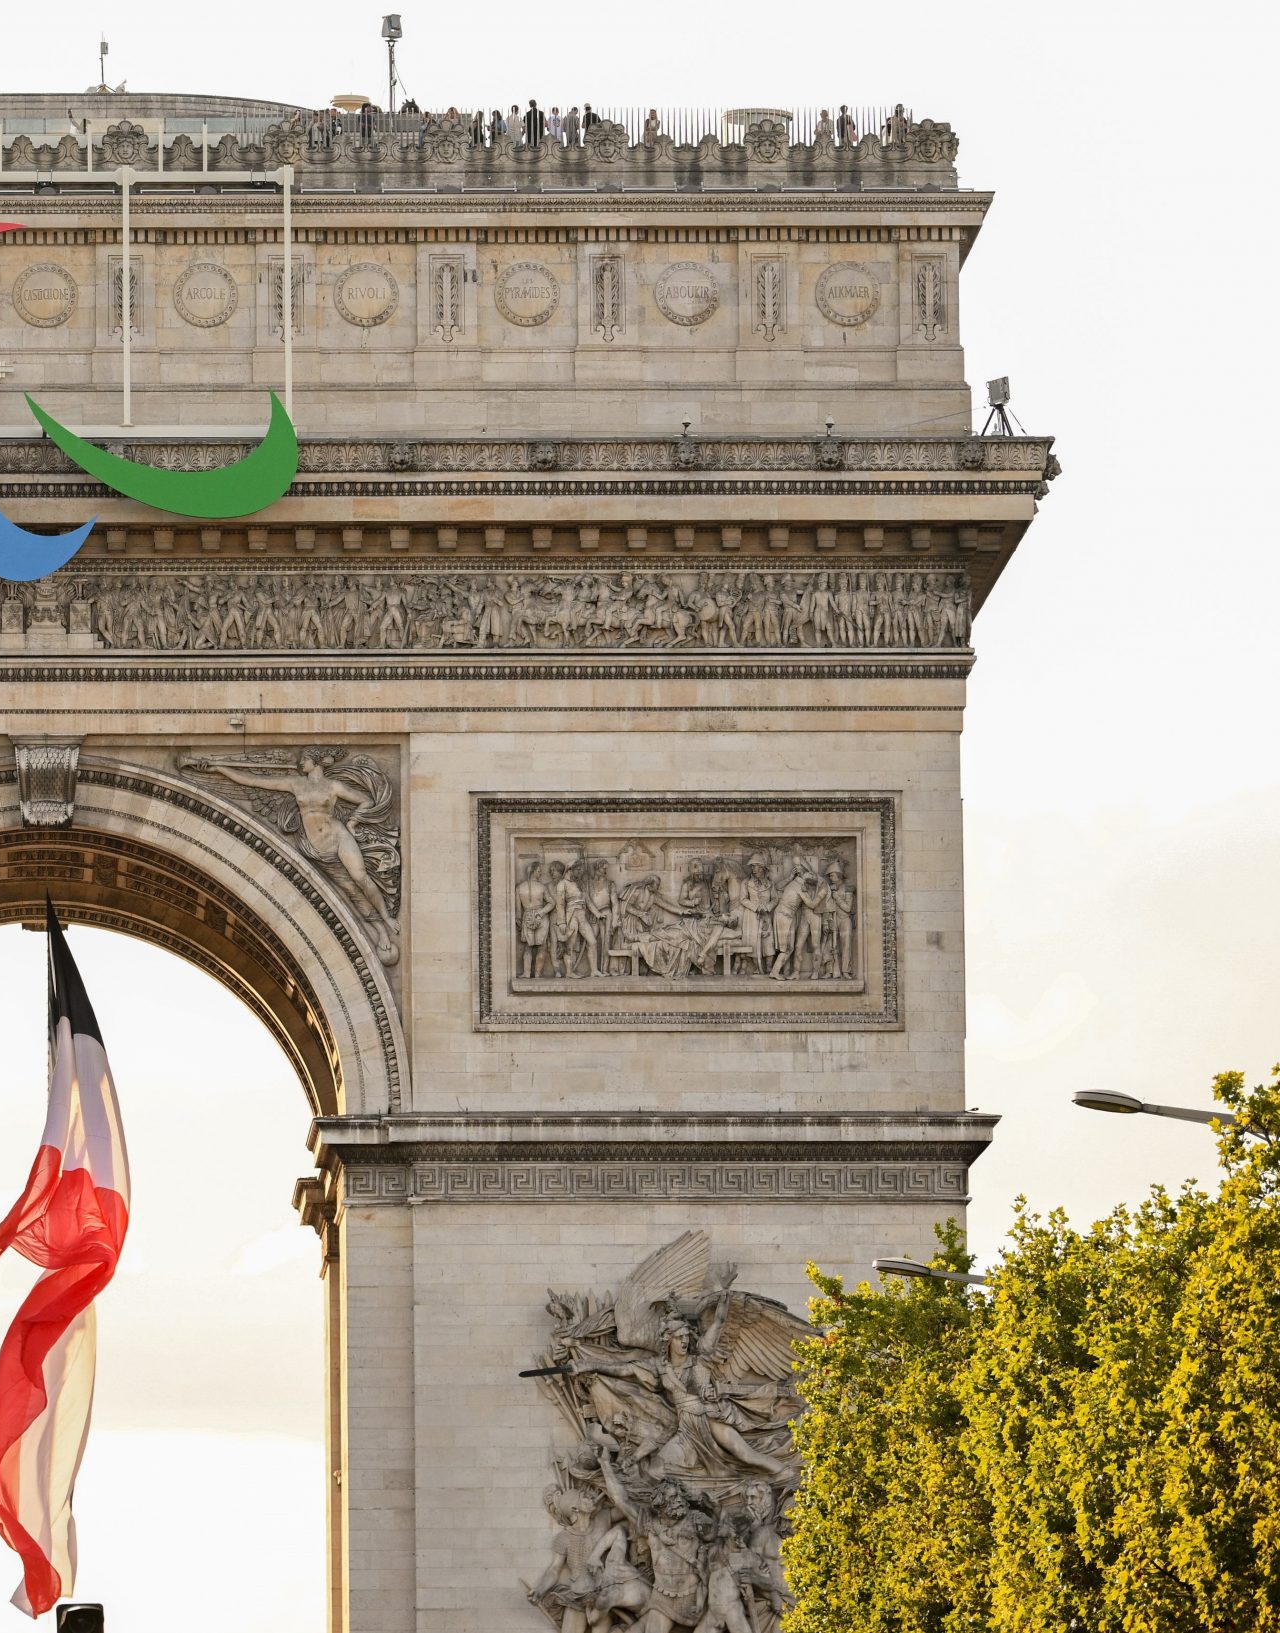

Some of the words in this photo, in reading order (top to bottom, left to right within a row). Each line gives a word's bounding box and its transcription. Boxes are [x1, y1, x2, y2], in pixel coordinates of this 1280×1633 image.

[186, 287, 226, 300] ARCOLE
[347, 287, 386, 300] RIVOLI
[504, 286, 551, 300] PYRAMIDES
[665, 285, 710, 299] ABOUKIR
[827, 285, 870, 299] ALKMAER
